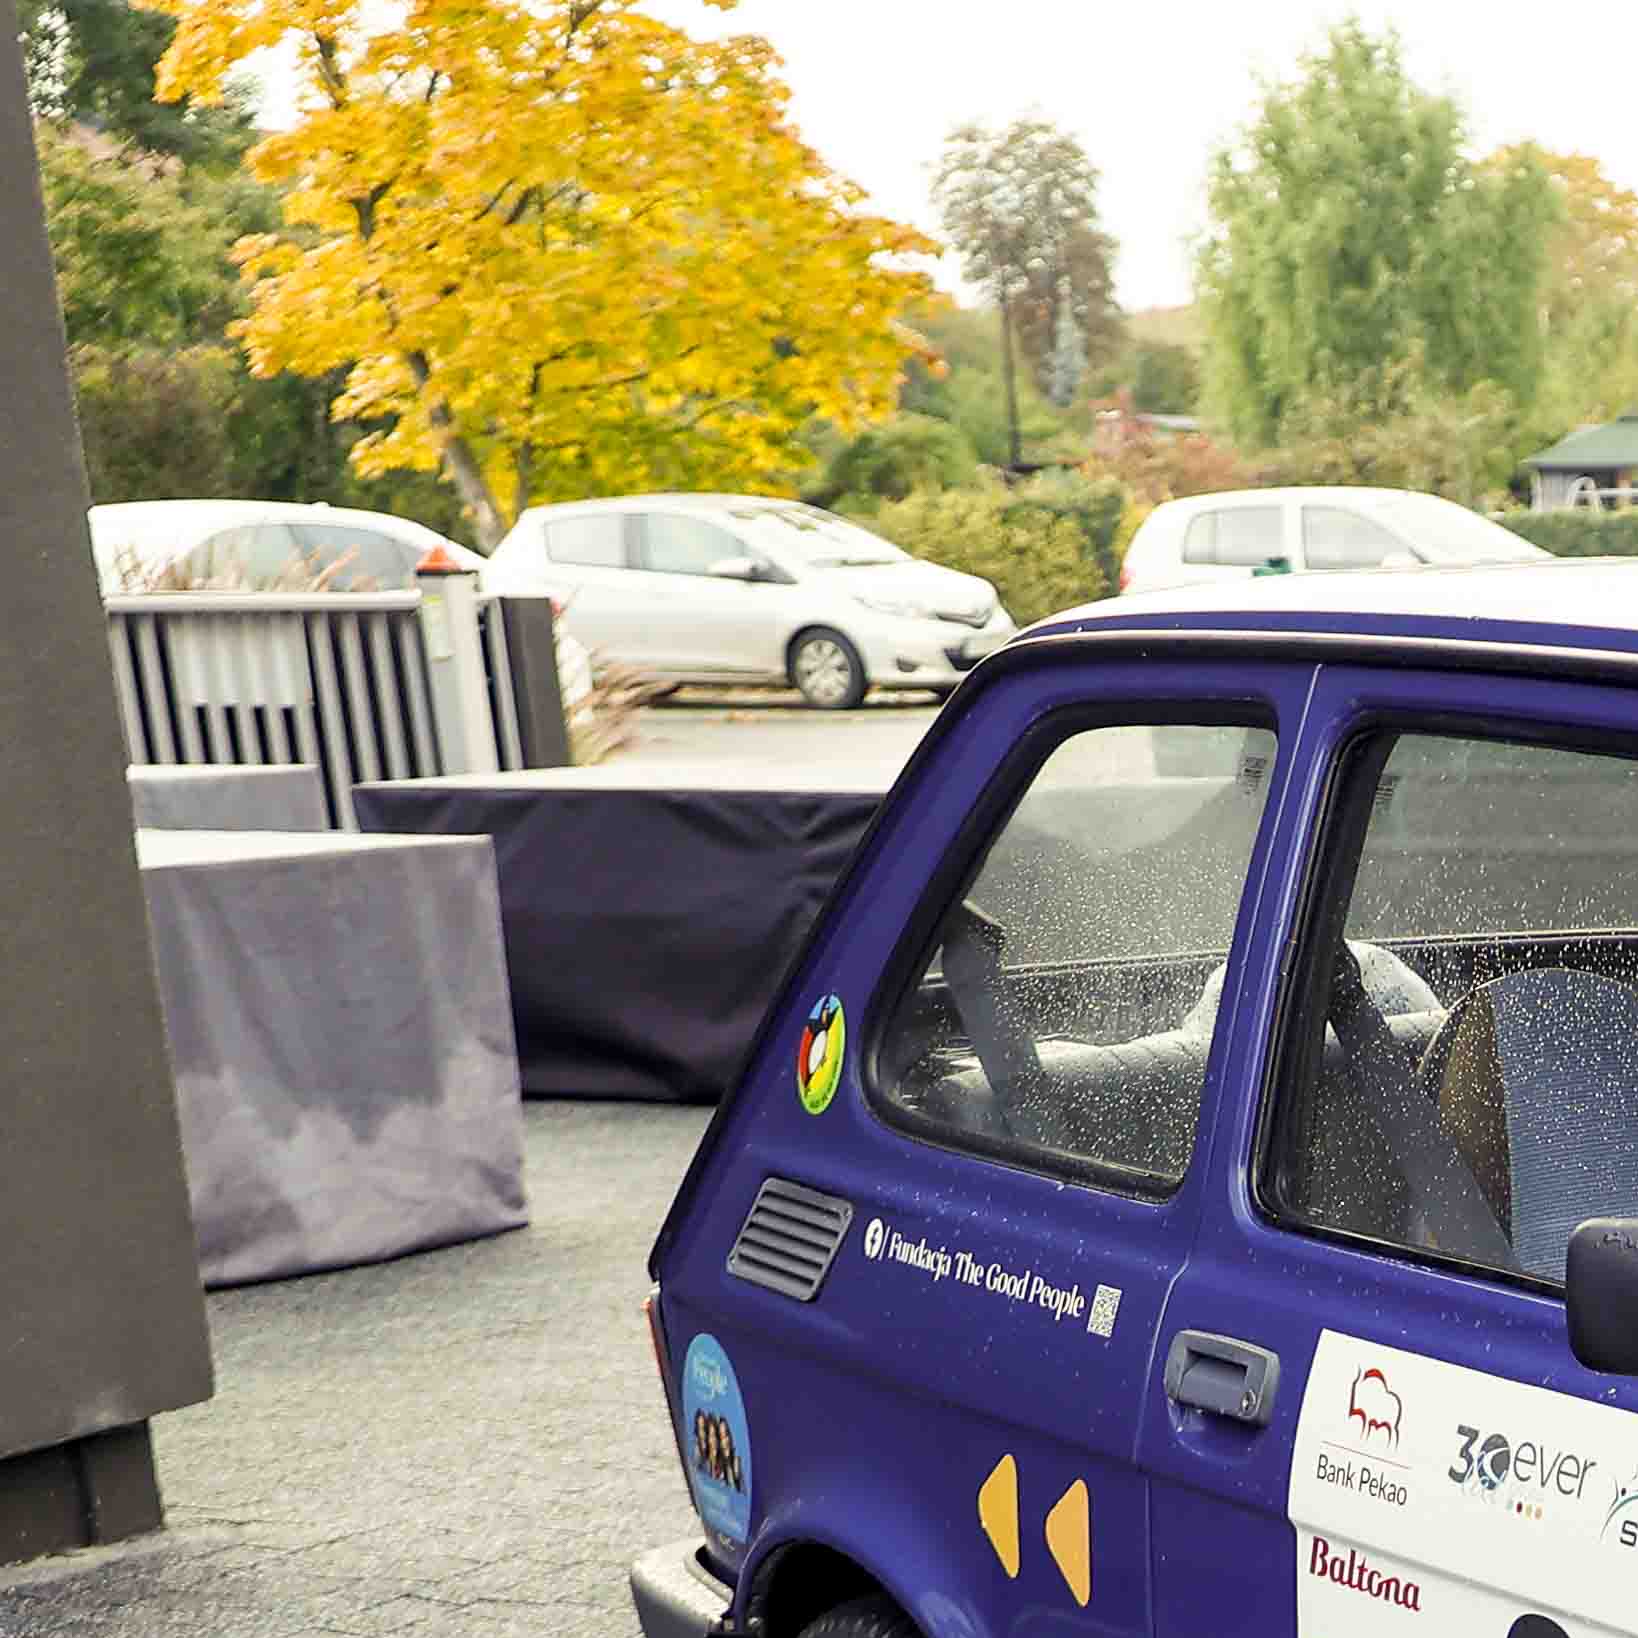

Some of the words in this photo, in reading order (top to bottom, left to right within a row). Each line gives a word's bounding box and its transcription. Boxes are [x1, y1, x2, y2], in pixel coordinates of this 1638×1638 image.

[888, 1232, 951, 1281] Fundacja
[955, 1252, 983, 1287] The
[985, 1265, 1029, 1301] Good
[1029, 1275, 1084, 1318] People
[1316, 1454, 1354, 1491] Bank
[1357, 1462, 1408, 1506] Pekao
[1309, 1536, 1421, 1612] Baltona
